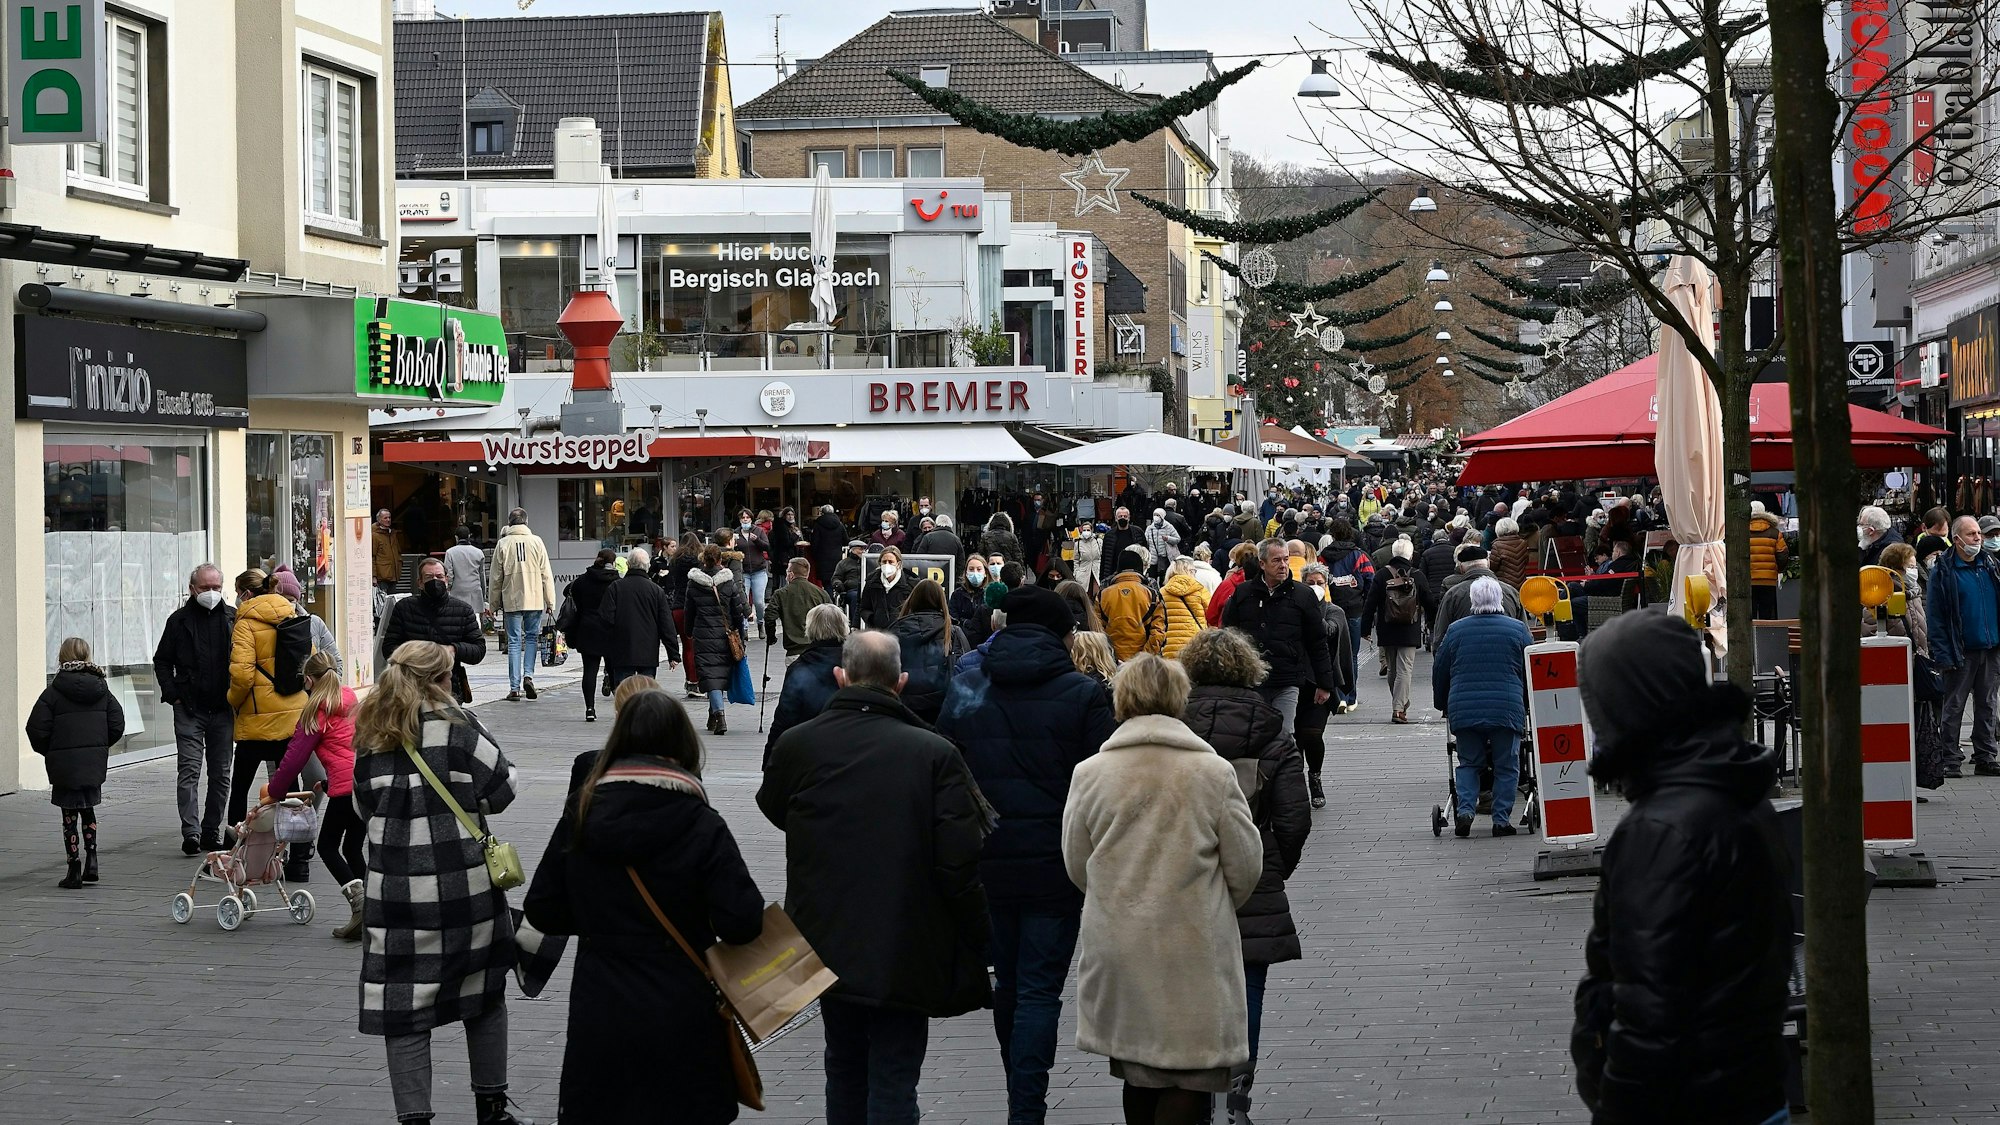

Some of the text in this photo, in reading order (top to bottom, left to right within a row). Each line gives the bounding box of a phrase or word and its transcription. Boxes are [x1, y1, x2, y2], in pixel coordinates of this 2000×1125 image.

[21, 5, 82, 132] DE
[951, 204, 978, 217] TUI
[717, 243, 811, 261] Hier buc
[669, 268, 768, 292] Bergisch
[1071, 241, 1088, 375] RÖSELER
[394, 334, 510, 401] BoBoQ Bubble Tea
[1192, 330, 1202, 371] WILMS
[868, 380, 1031, 413] BREMER
